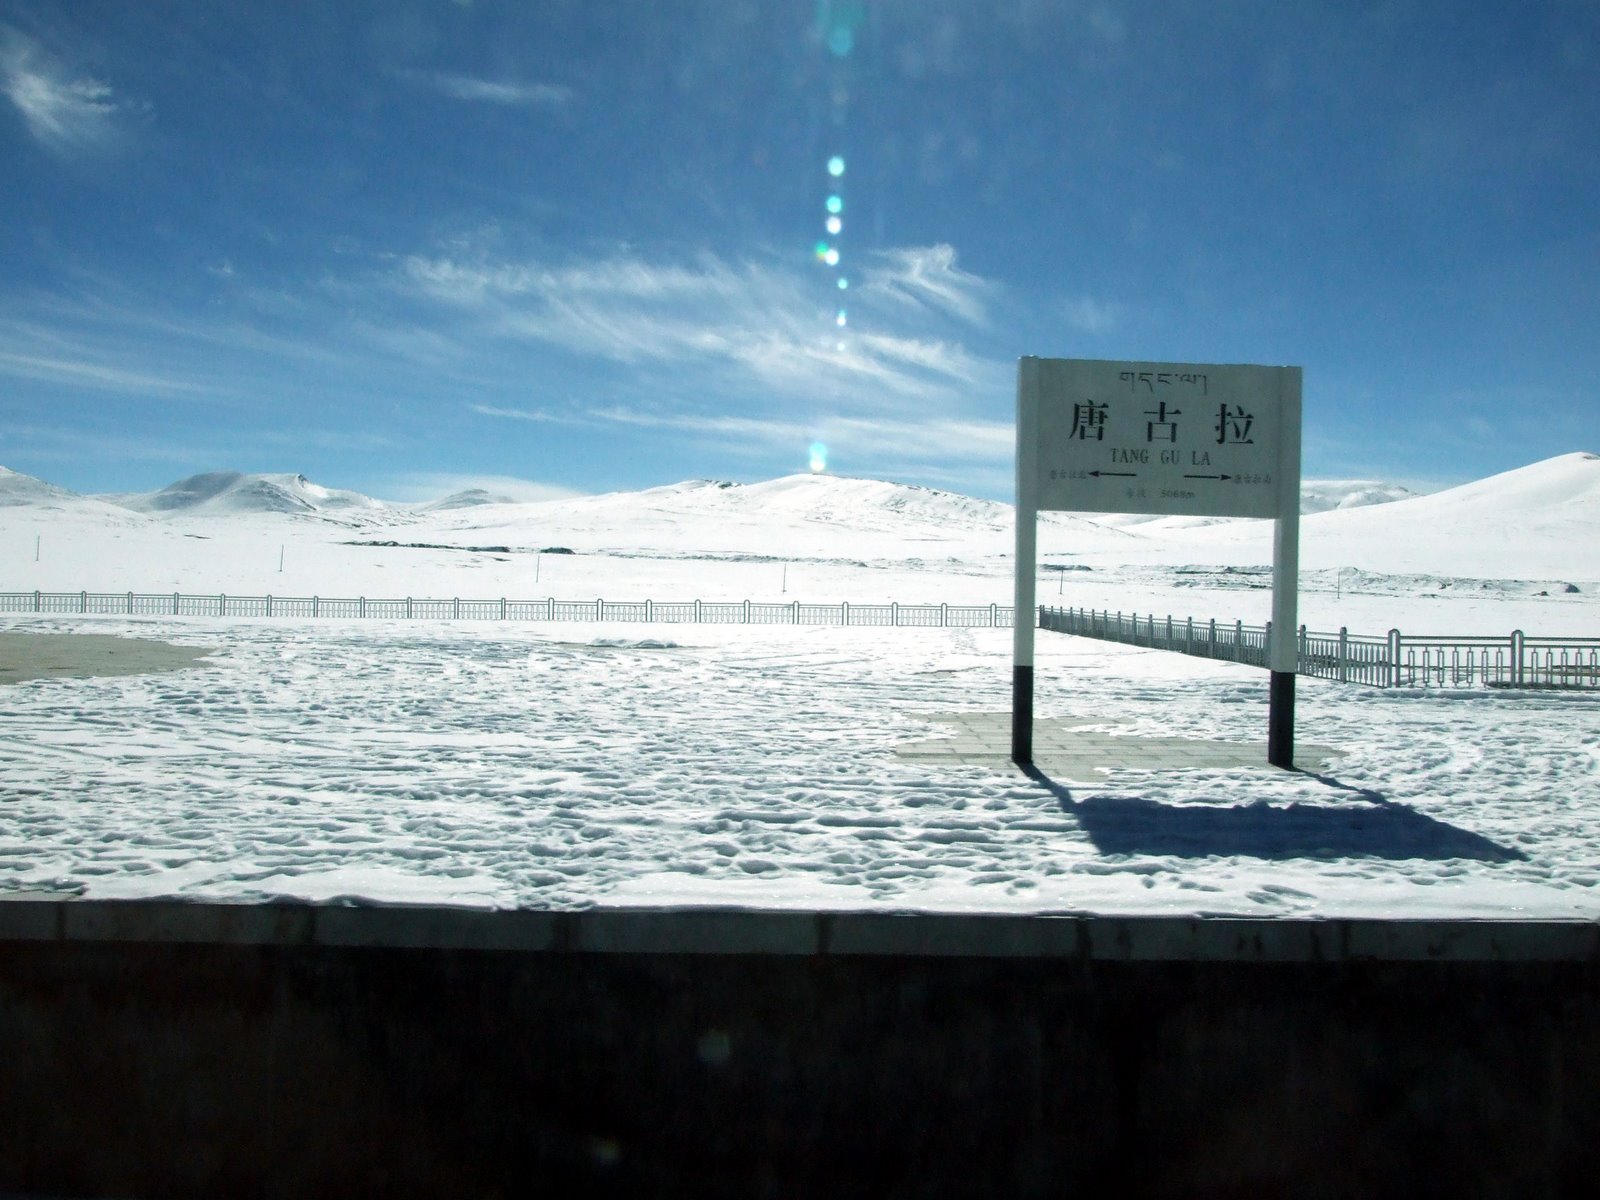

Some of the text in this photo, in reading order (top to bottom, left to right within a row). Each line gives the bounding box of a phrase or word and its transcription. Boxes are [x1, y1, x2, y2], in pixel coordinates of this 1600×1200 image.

[1068, 398, 1255, 445] 唐古拉
[1110, 447, 1212, 466] TANG GU LA
